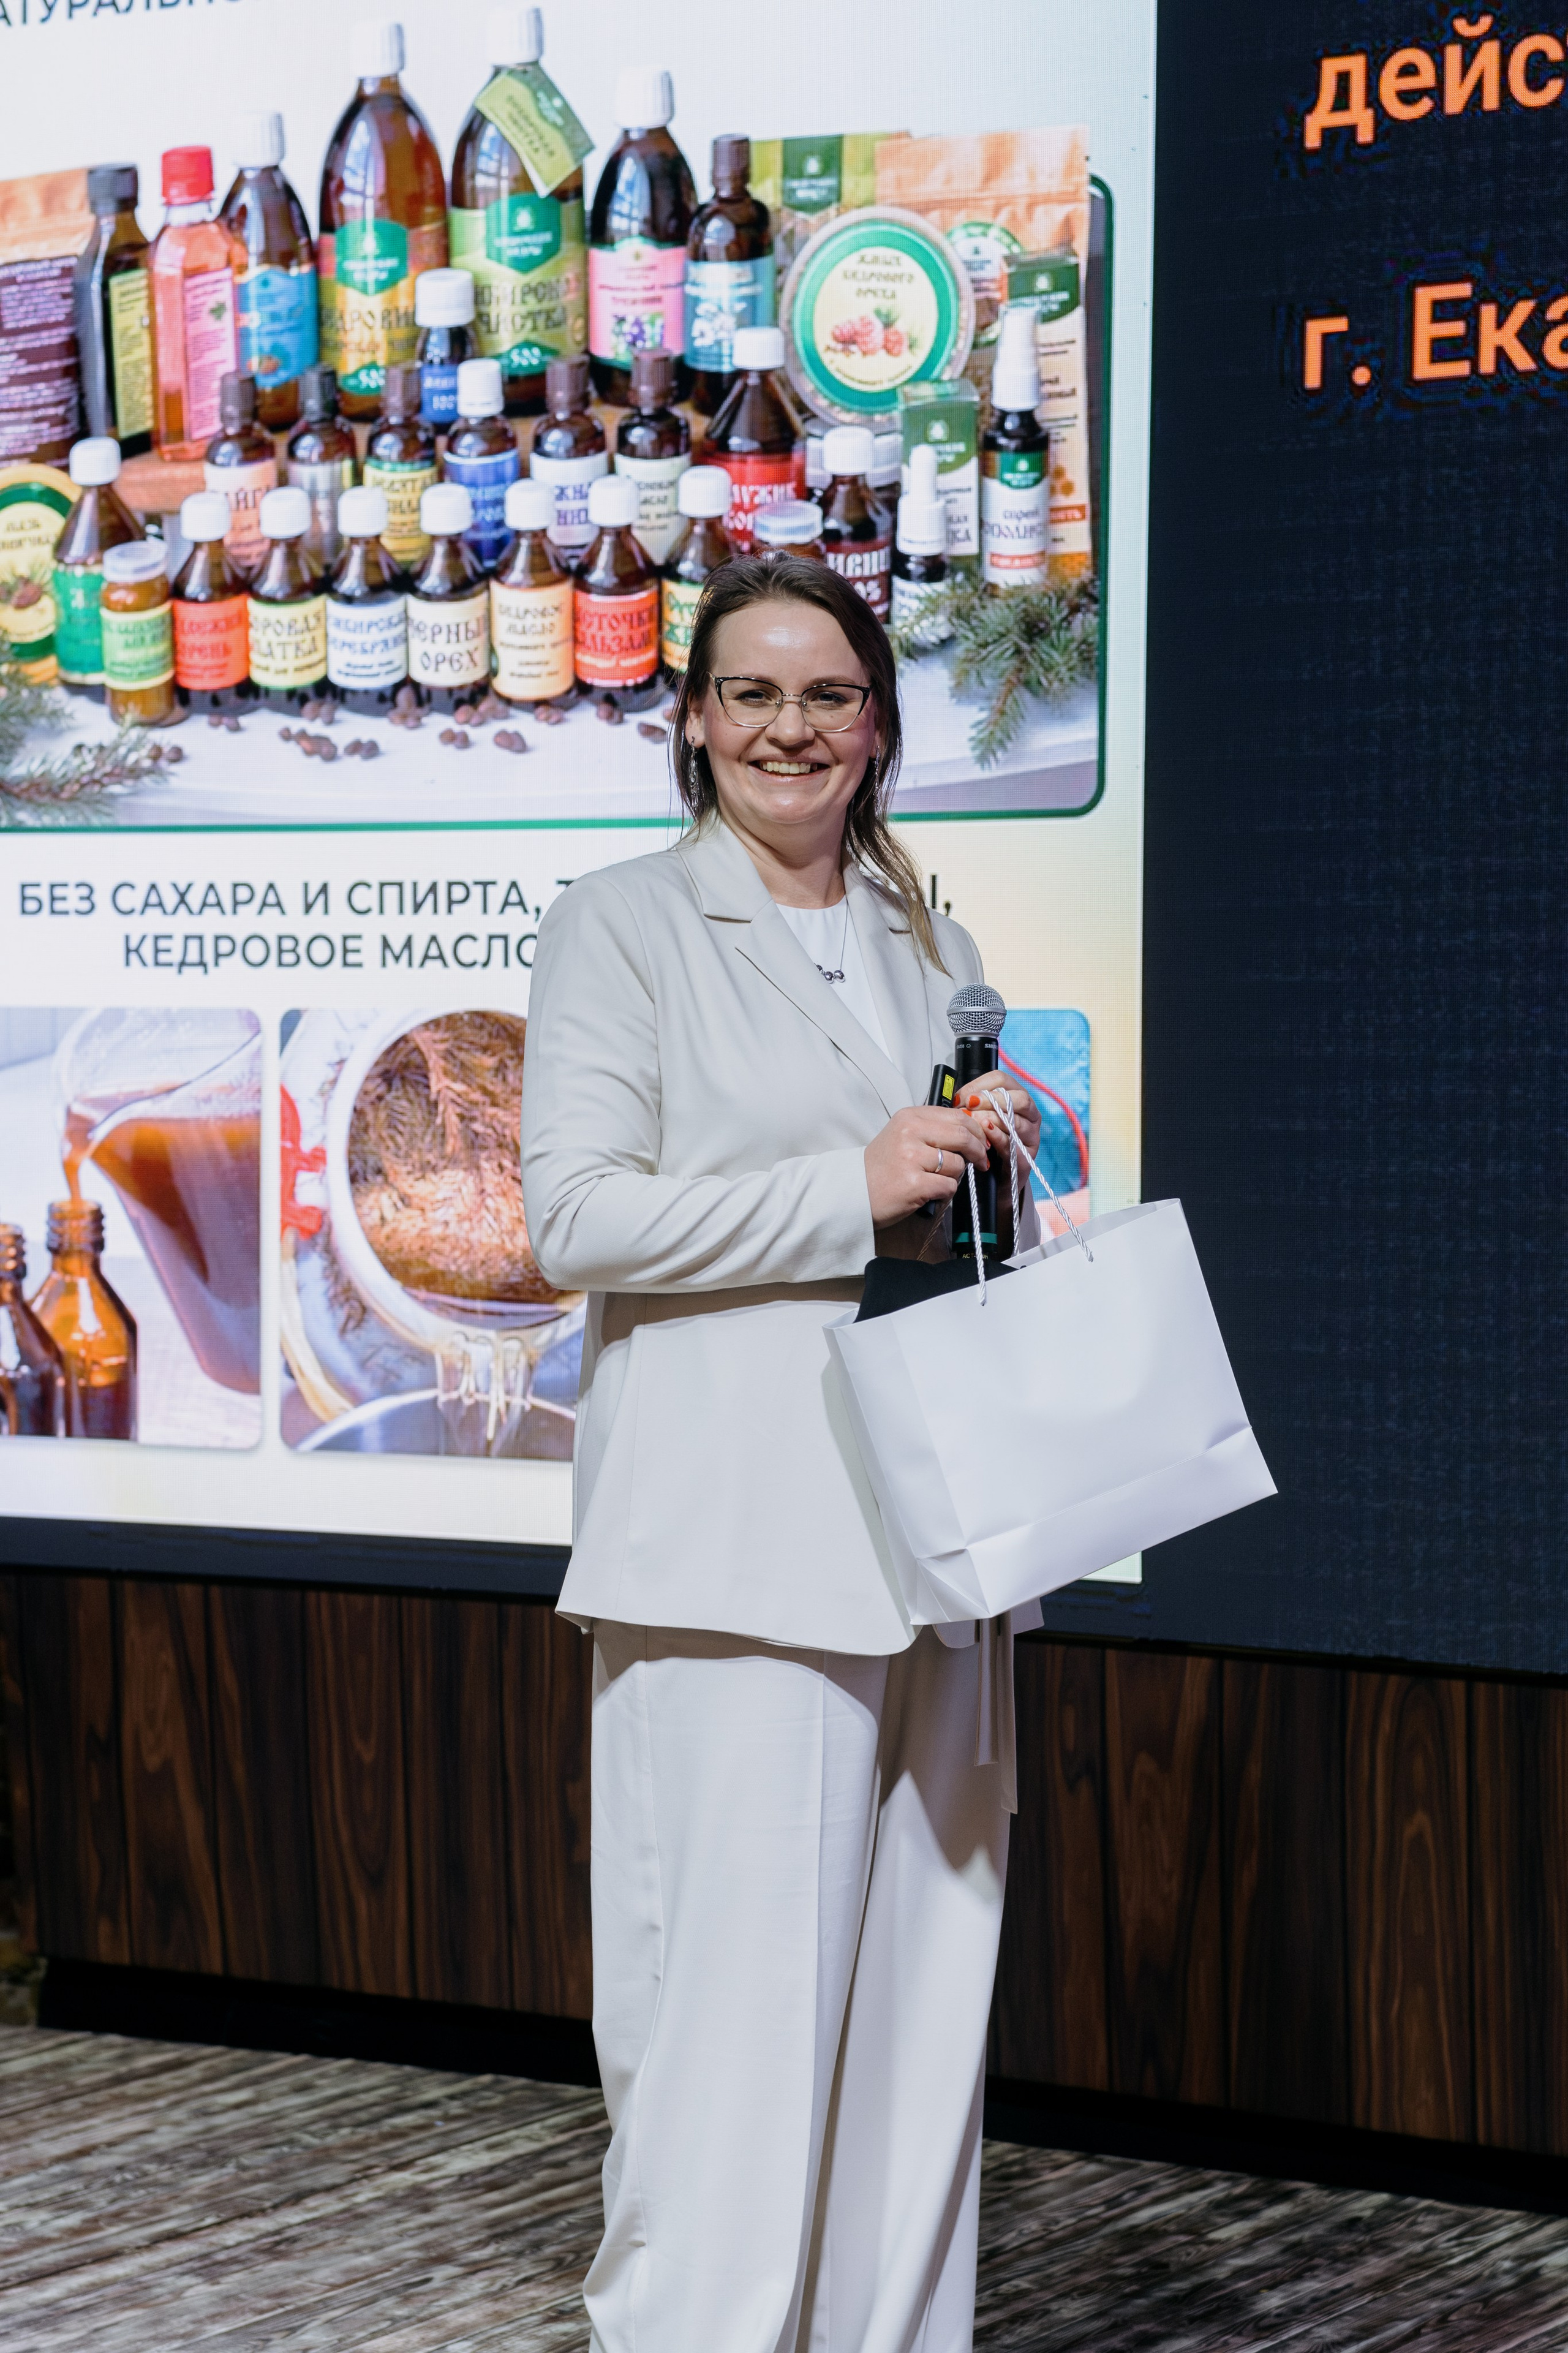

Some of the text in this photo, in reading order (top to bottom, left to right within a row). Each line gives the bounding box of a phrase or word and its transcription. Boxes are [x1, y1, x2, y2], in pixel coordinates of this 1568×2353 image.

[1305, 15, 1568, 149] дейс
[1305, 316, 1371, 390] г.
[20, 880, 541, 922] БЕЗ САХАРА И СПИРТА,
[125, 934, 363, 975] КЕДРОВОЕ
